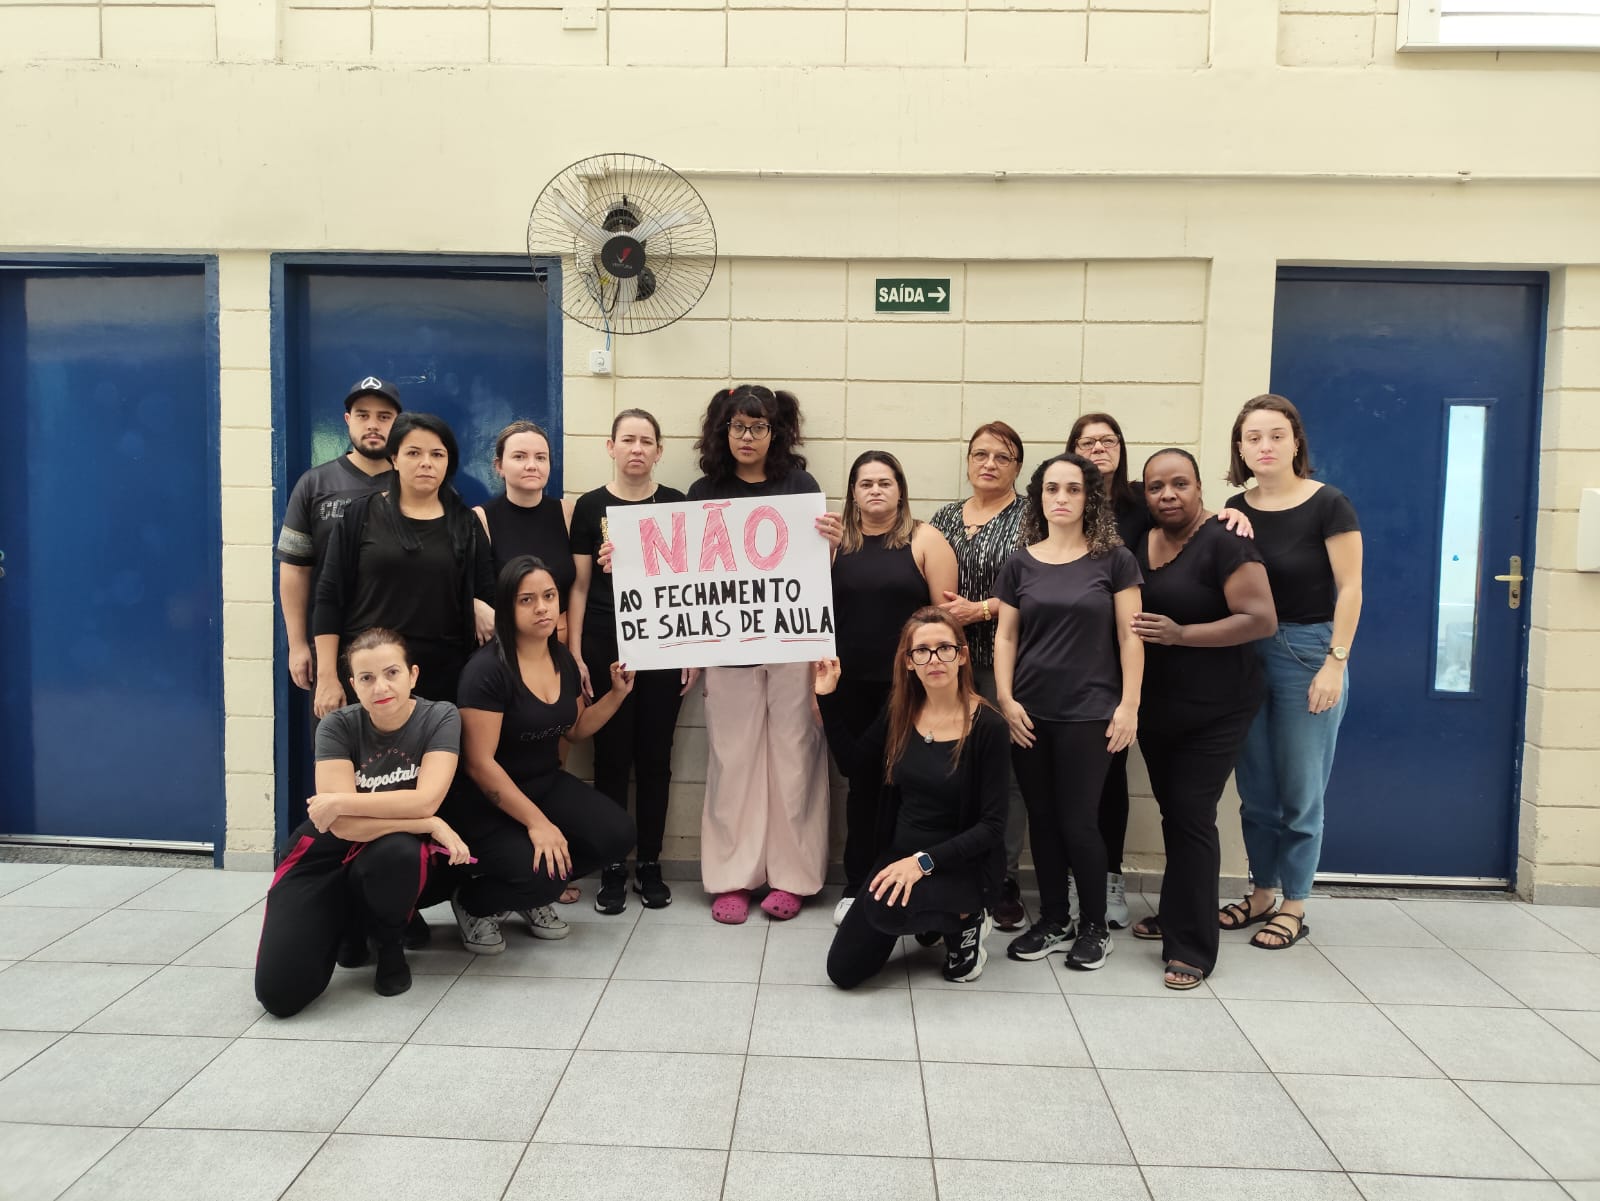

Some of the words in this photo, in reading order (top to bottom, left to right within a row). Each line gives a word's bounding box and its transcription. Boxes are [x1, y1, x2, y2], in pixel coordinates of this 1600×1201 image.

[879, 283, 925, 303] SAÍDA
[638, 500, 788, 577] NÃO
[620, 589, 643, 613] AO
[654, 578, 801, 609] FECHAMENTO
[621, 618, 650, 641] DE
[657, 610, 731, 640] SALAS
[740, 609, 765, 633] DE
[774, 606, 834, 635] AULA
